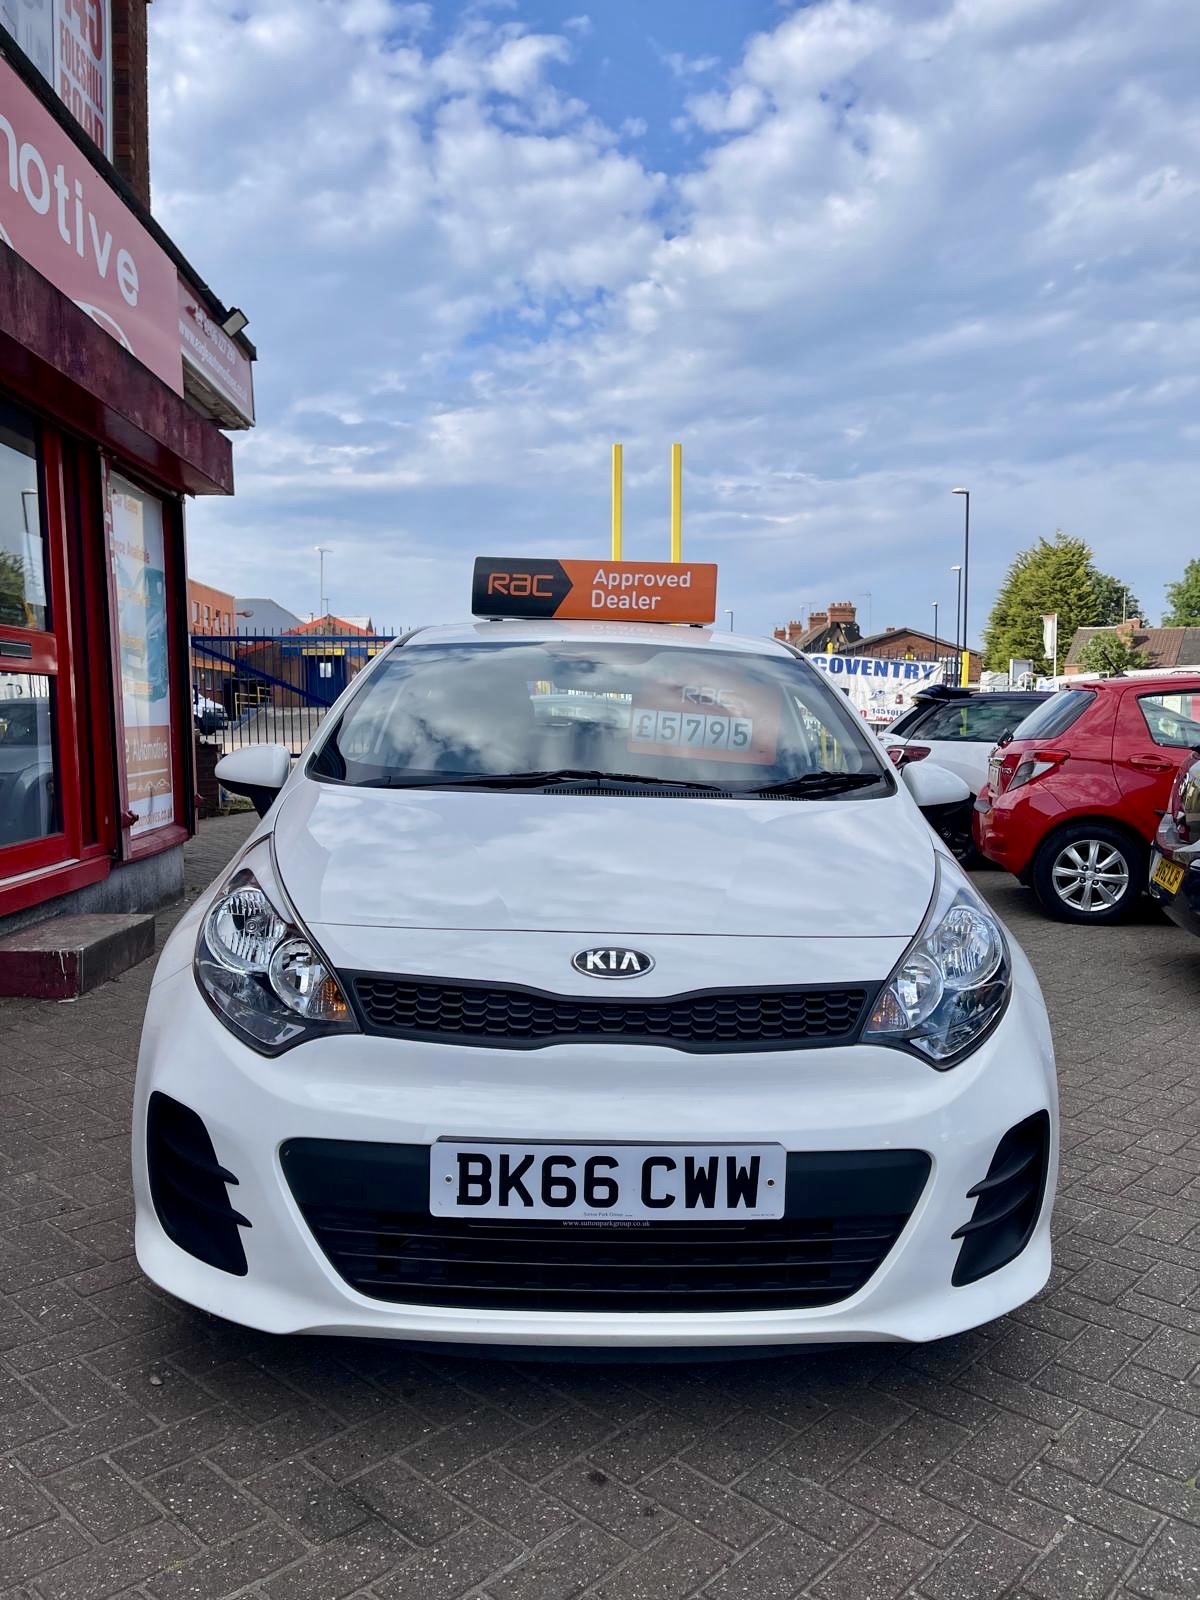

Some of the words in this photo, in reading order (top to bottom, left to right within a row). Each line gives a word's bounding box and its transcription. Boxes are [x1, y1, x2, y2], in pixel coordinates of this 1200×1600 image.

[61, 18, 104, 115] FOLESHILL
[592, 568, 692, 590] Approved
[591, 589, 661, 610] Dealer
[812, 656, 936, 681] COVENTRY
[635, 714, 749, 747] £5795
[132, 736, 168, 761] Automotive
[586, 950, 641, 971] KIA
[456, 1152, 620, 1209] BK66
[640, 1155, 761, 1209] CWW
[562, 1220, 651, 1228] www.suttonparkgroup.co.uk
